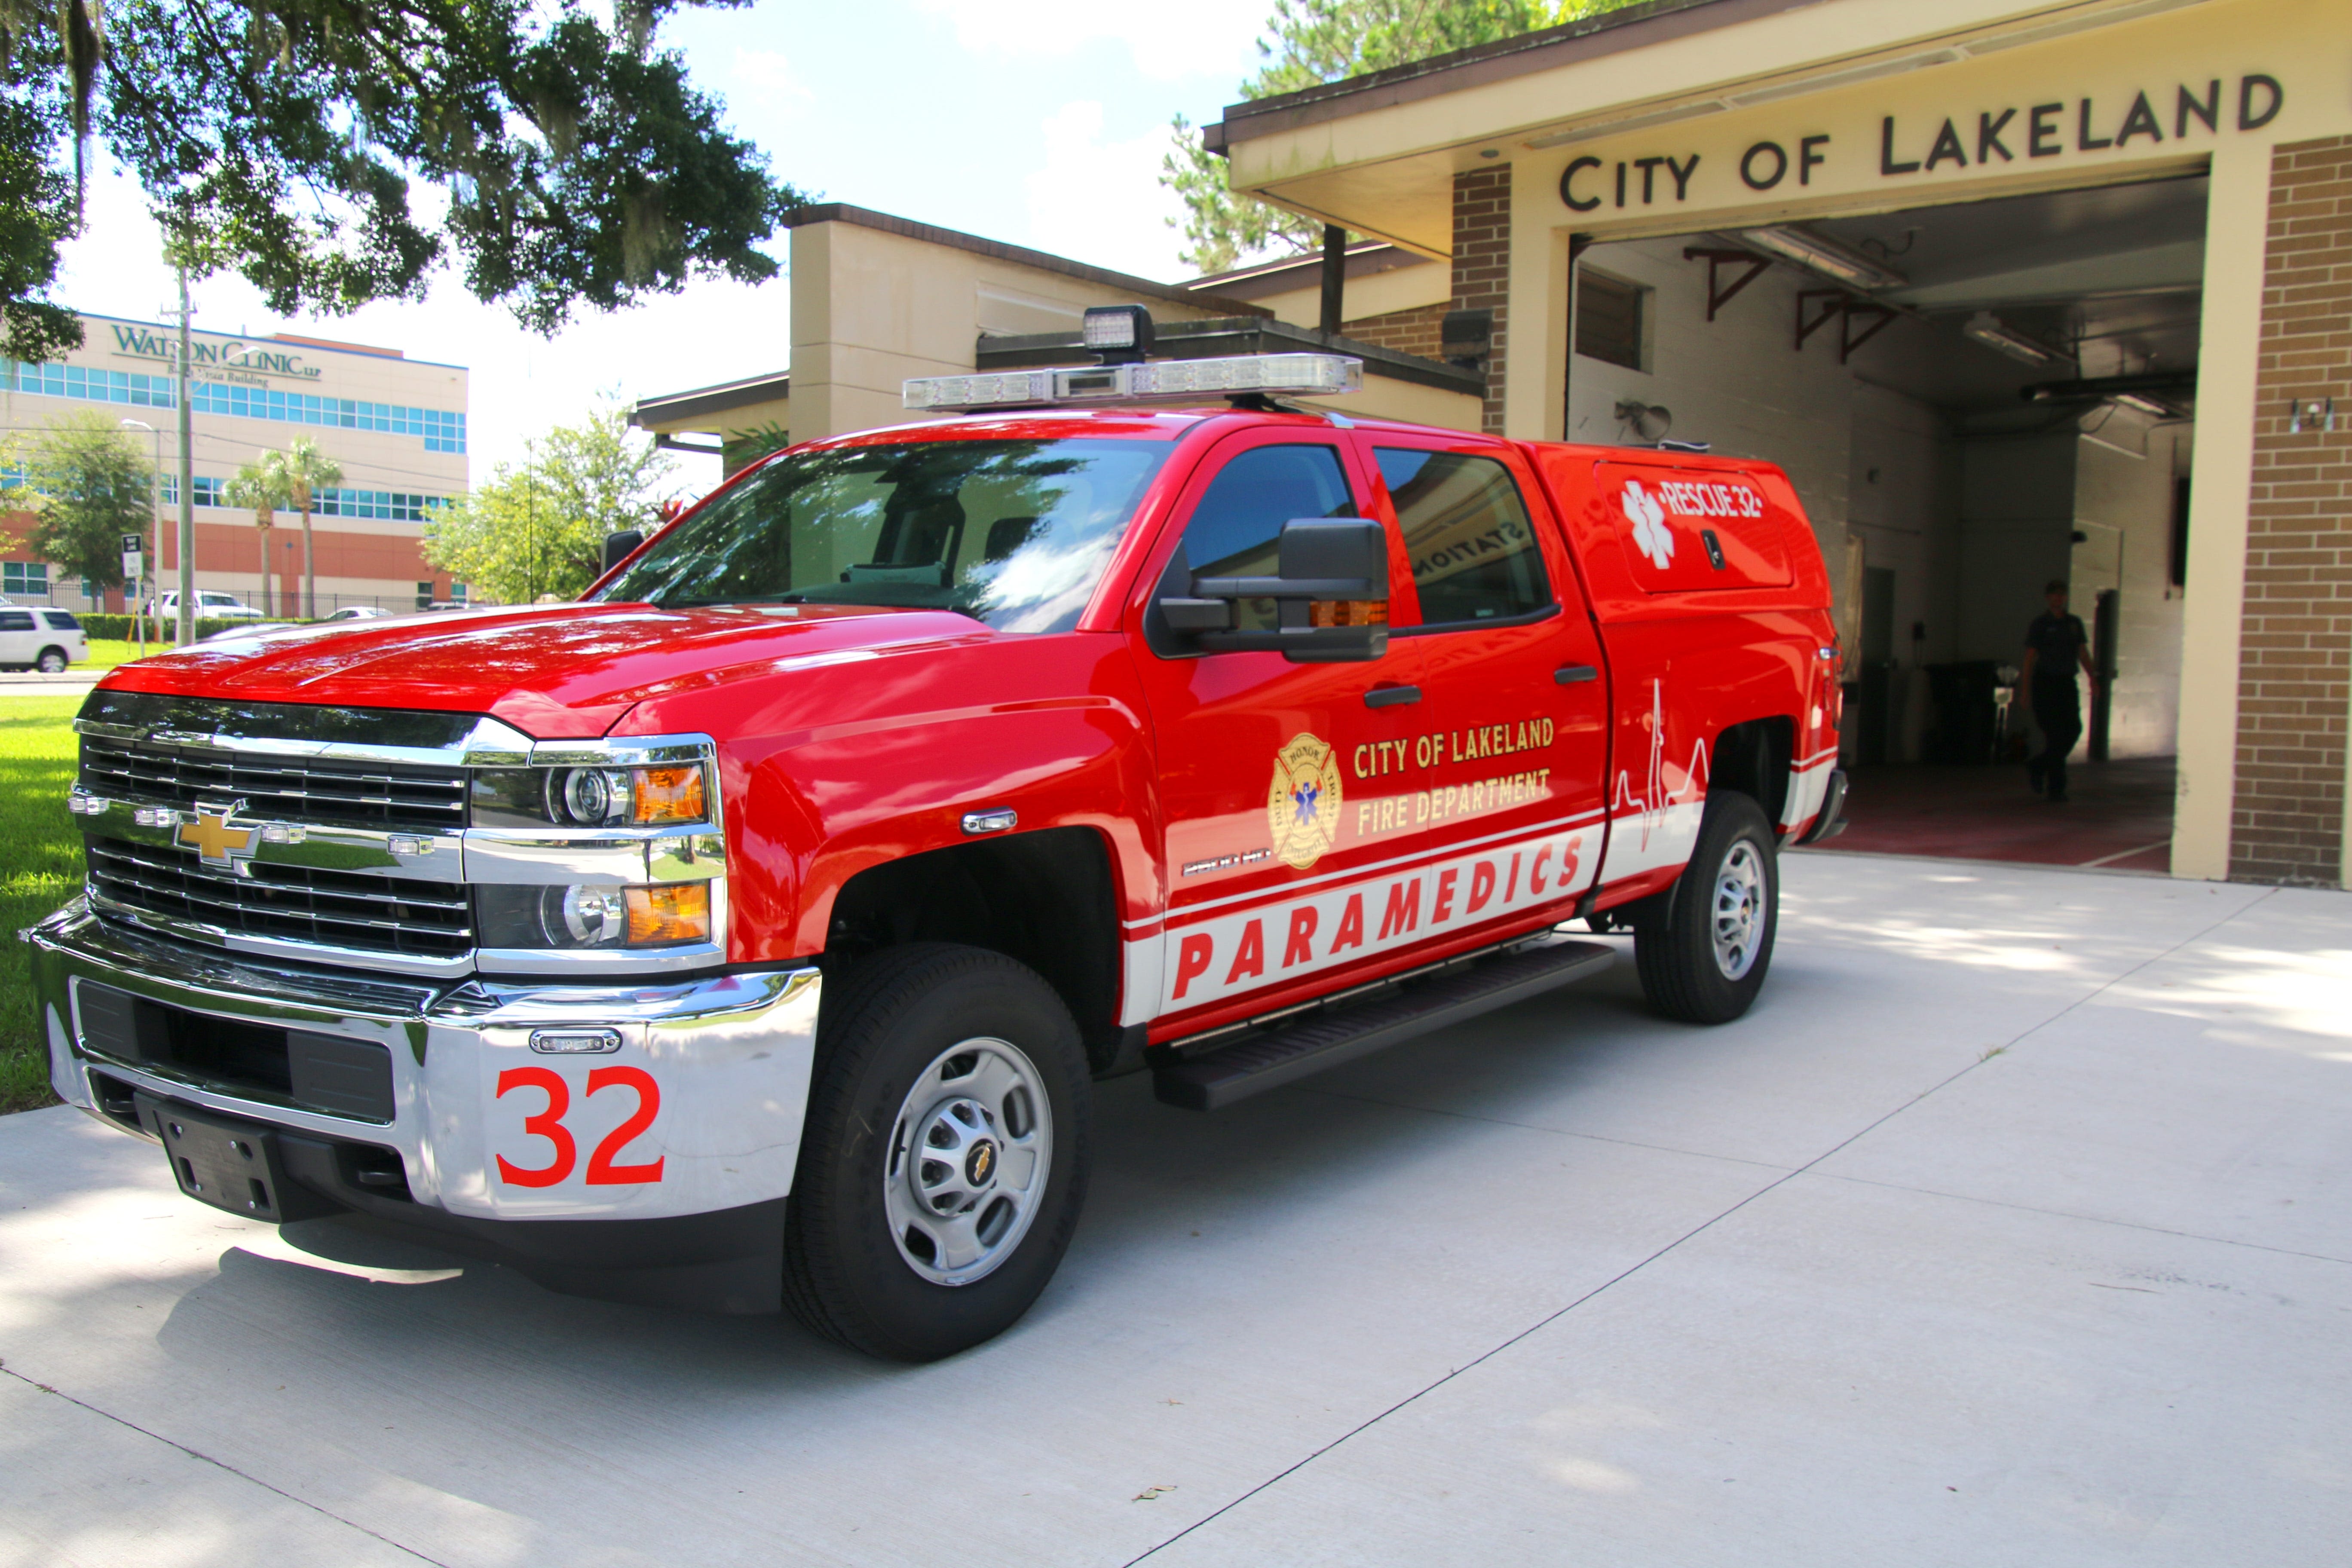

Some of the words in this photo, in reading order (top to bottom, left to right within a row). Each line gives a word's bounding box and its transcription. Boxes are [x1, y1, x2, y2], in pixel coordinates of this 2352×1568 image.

[1559, 154, 1701, 212] CITY
[1740, 134, 1831, 191] OF
[1881, 74, 2284, 175] LAKELAND
[228, 372, 269, 389] Building
[1289, 746, 1320, 764] HONOR
[1354, 738, 1408, 780] CITY
[1416, 733, 1445, 769] OF
[1452, 717, 1554, 763] LAKELAND
[1357, 794, 1409, 837] FIRE
[1416, 768, 1551, 825] DEPARTMENT
[1240, 848, 1271, 865] HD
[1171, 835, 1583, 1001] PARAMEDICS
[495, 1066, 665, 1188] 32
